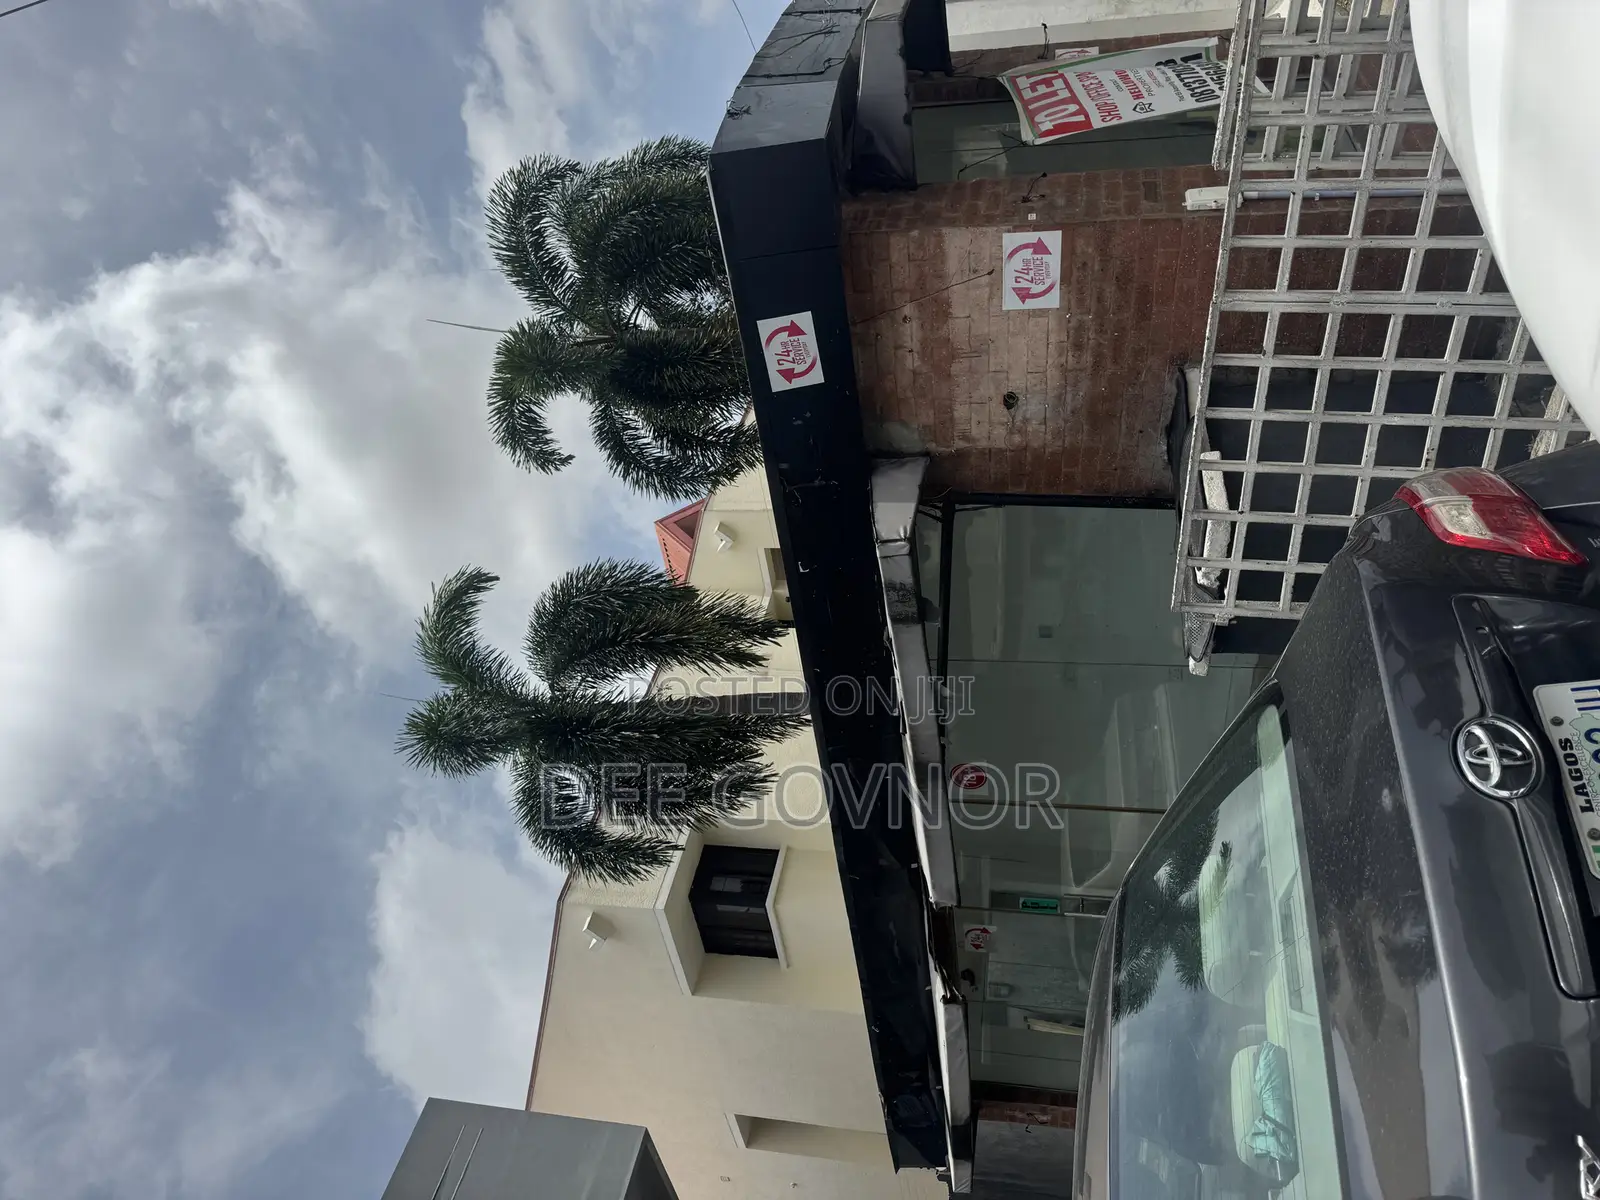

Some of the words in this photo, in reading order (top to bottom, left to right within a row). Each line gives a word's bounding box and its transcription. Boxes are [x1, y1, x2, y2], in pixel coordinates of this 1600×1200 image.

[1015, 73, 1071, 110] LET
[1034, 103, 1086, 132] TO
[1031, 257, 1046, 286] SERVICE
[789, 338, 807, 366] SERVICE
[1570, 732, 1592, 776] EXCELLENCE
[1558, 737, 1595, 813] LAGOS
